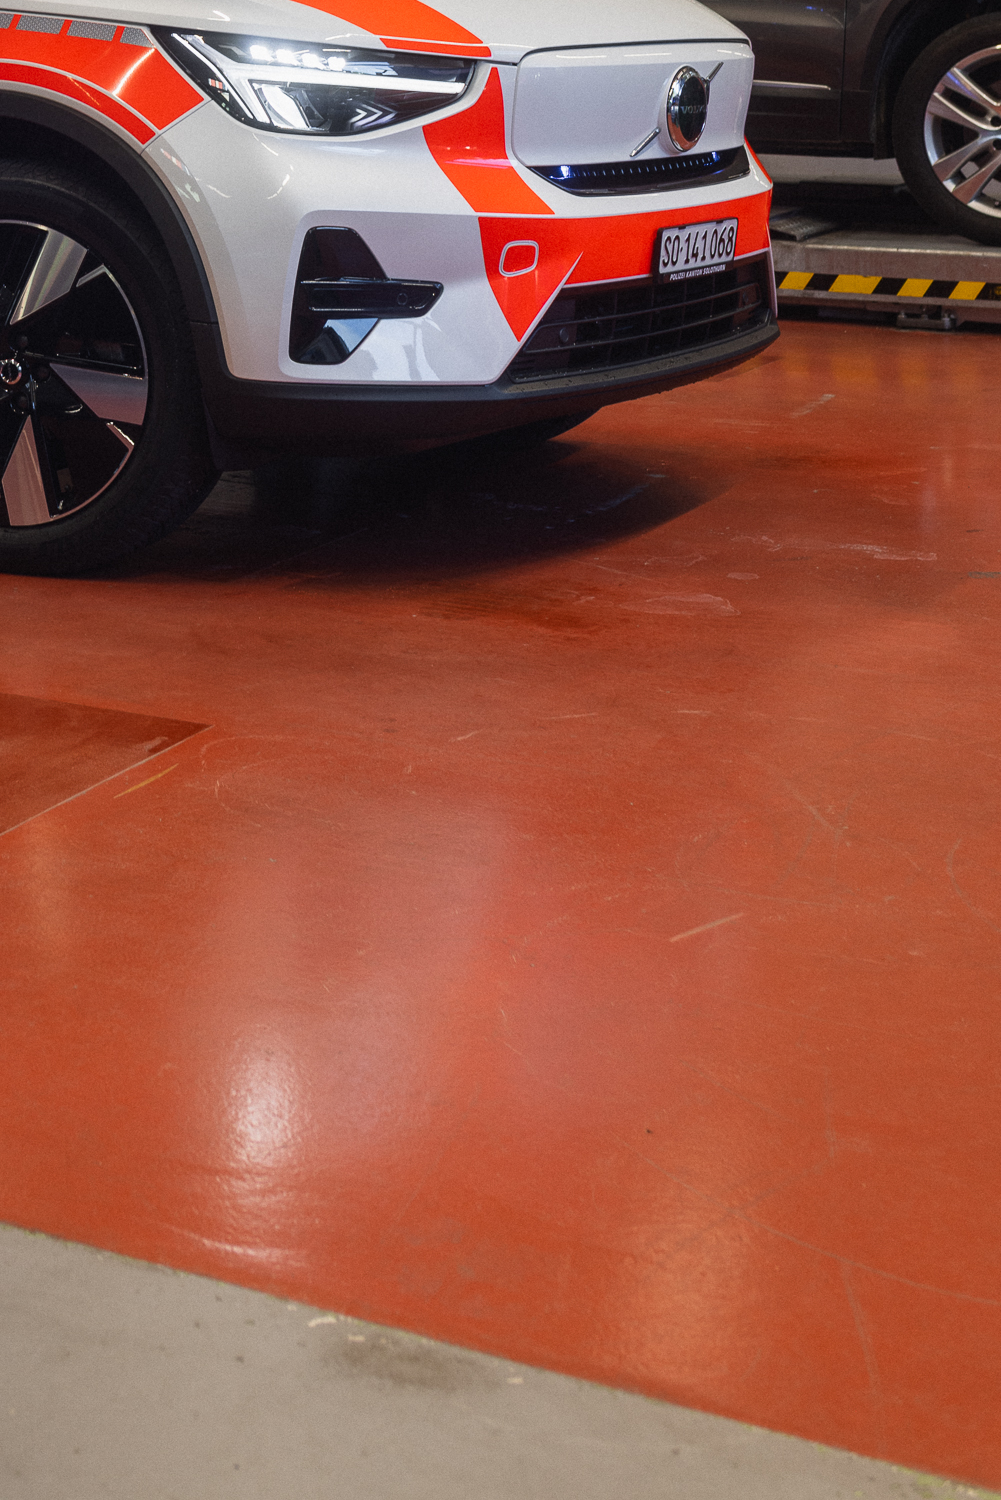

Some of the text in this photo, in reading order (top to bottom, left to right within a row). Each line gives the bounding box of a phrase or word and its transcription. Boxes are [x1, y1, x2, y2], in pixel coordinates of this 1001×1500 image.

[669, 263, 726, 281] POLIZEI KANTON SOLOTHURN
